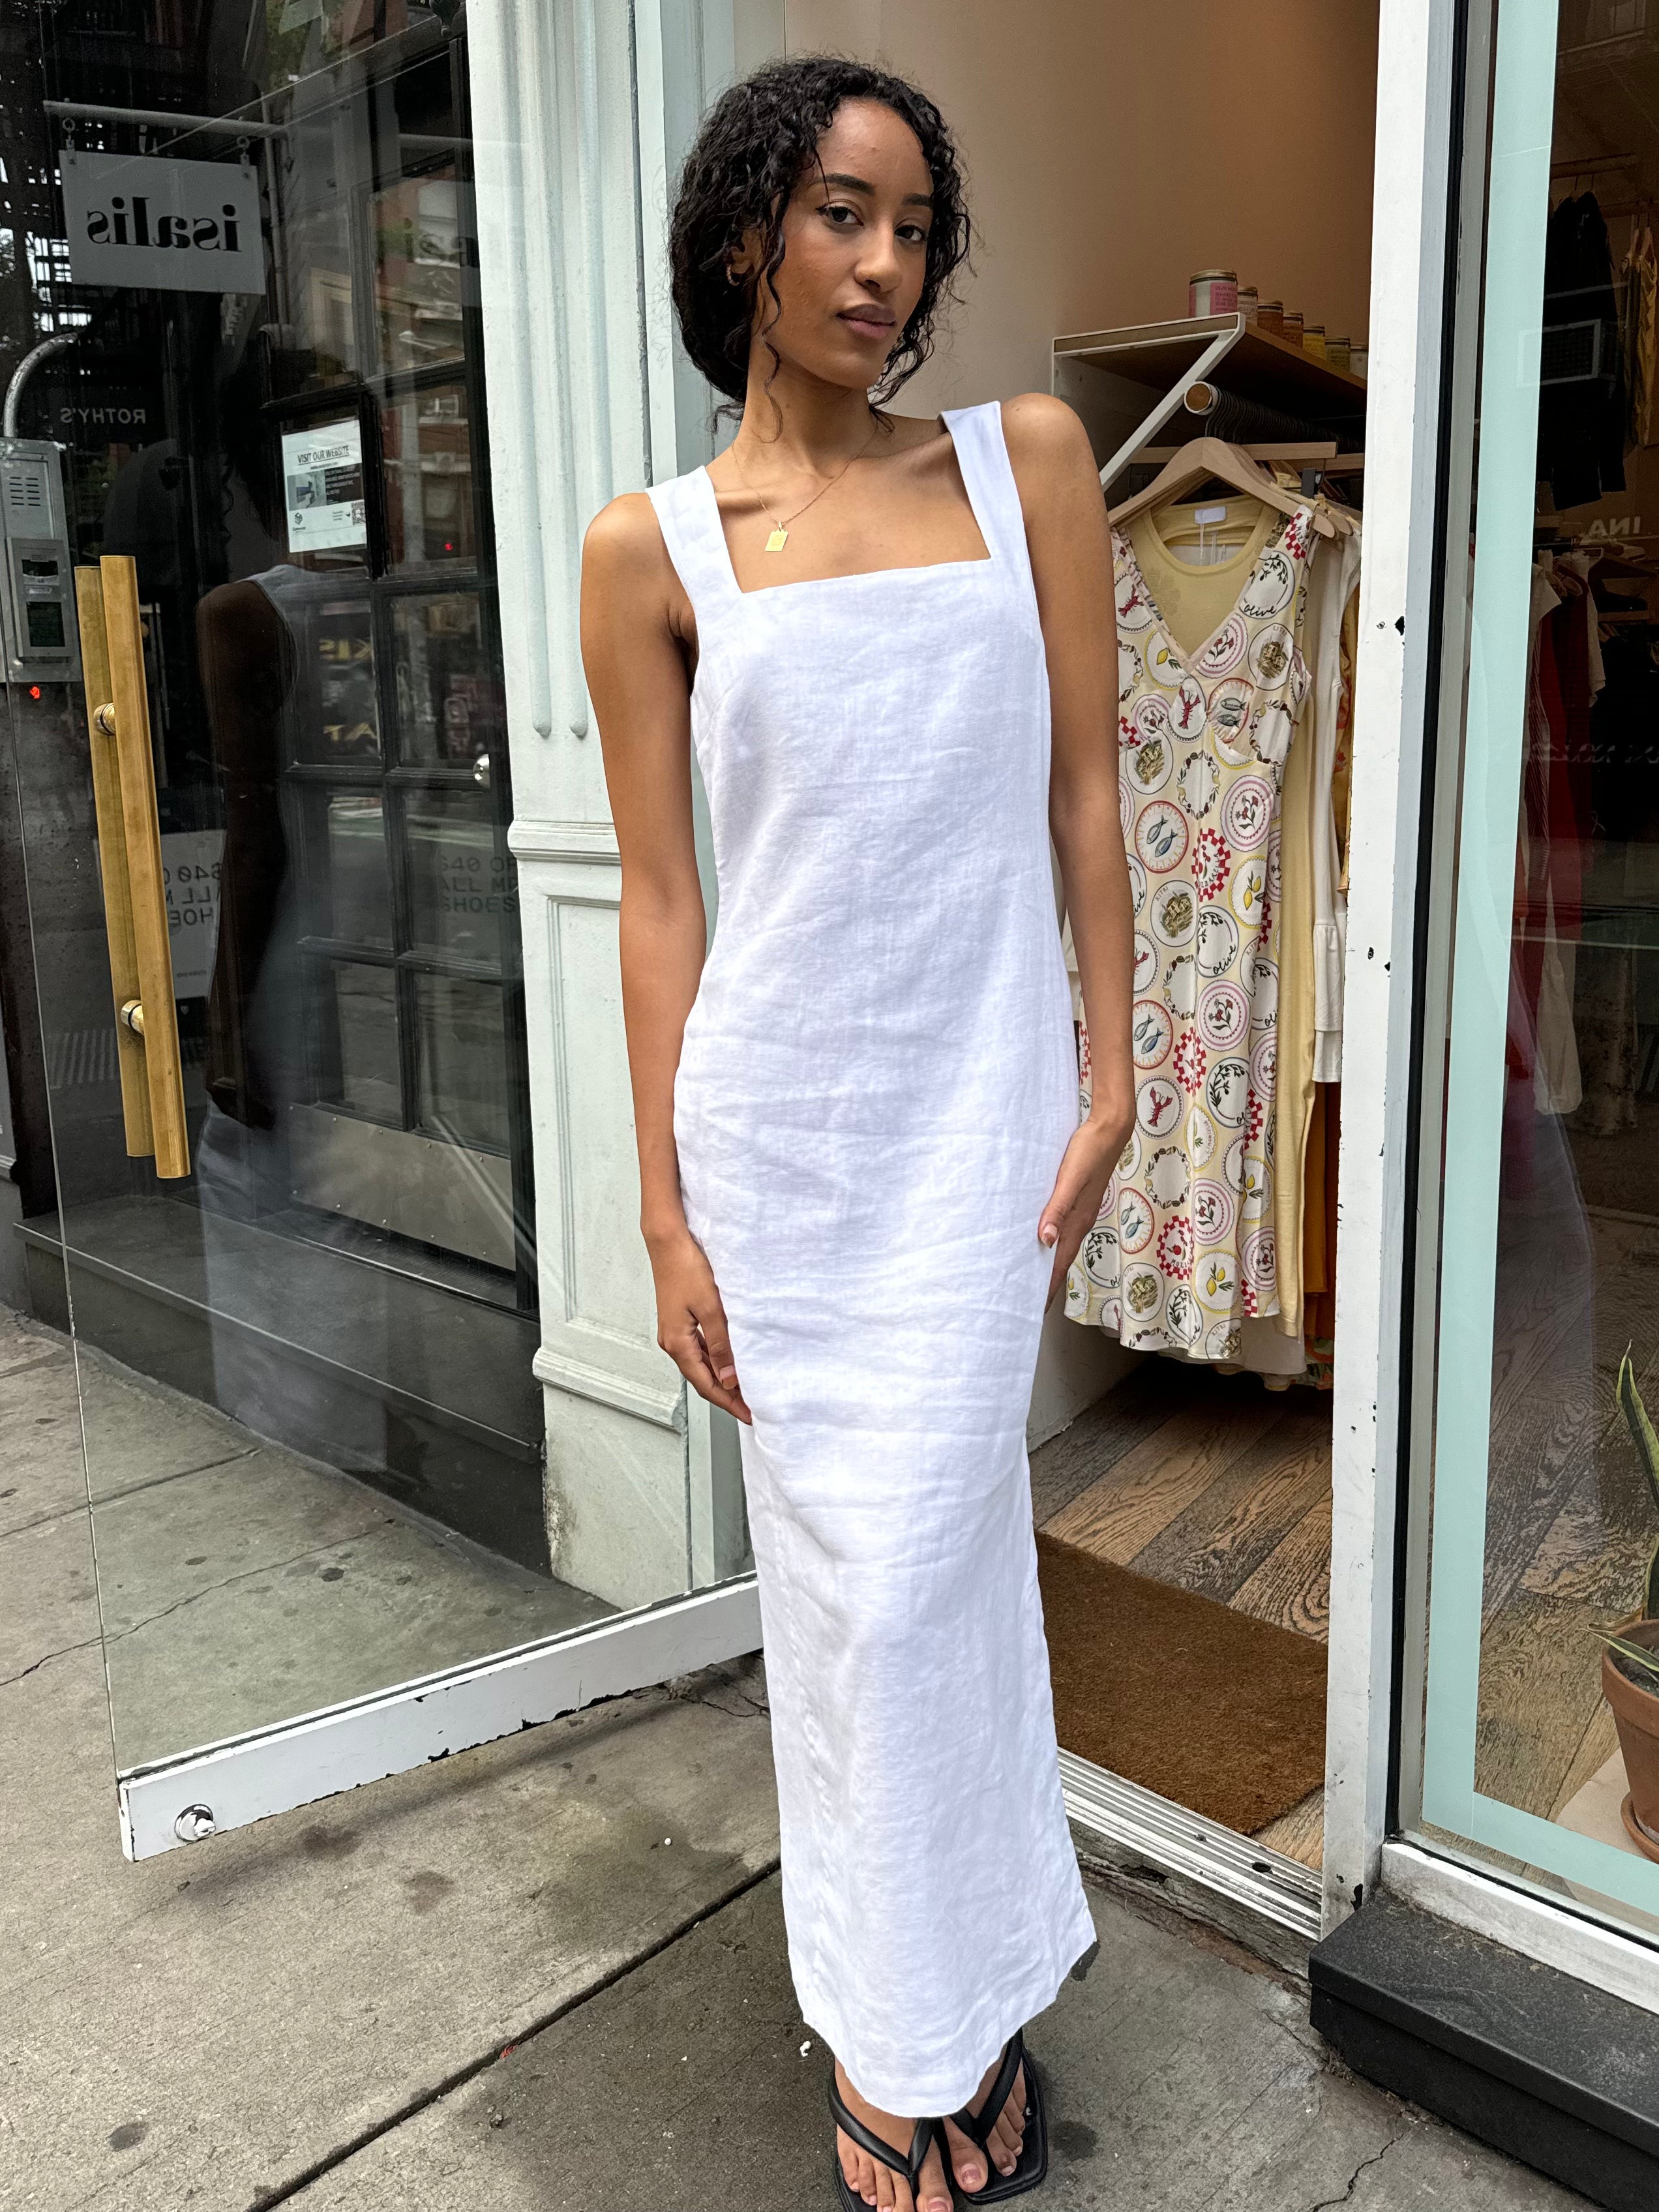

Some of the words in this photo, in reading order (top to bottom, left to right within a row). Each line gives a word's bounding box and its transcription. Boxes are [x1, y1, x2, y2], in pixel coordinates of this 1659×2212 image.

[297, 453, 312, 463] VISIT
[312, 450, 325, 460] OUR
[325, 445, 350, 458] WEBSITE
[1244, 605, 1278, 617] olive
[1155, 886, 1169, 902] KITRI
[1213, 943, 1236, 975] olive
